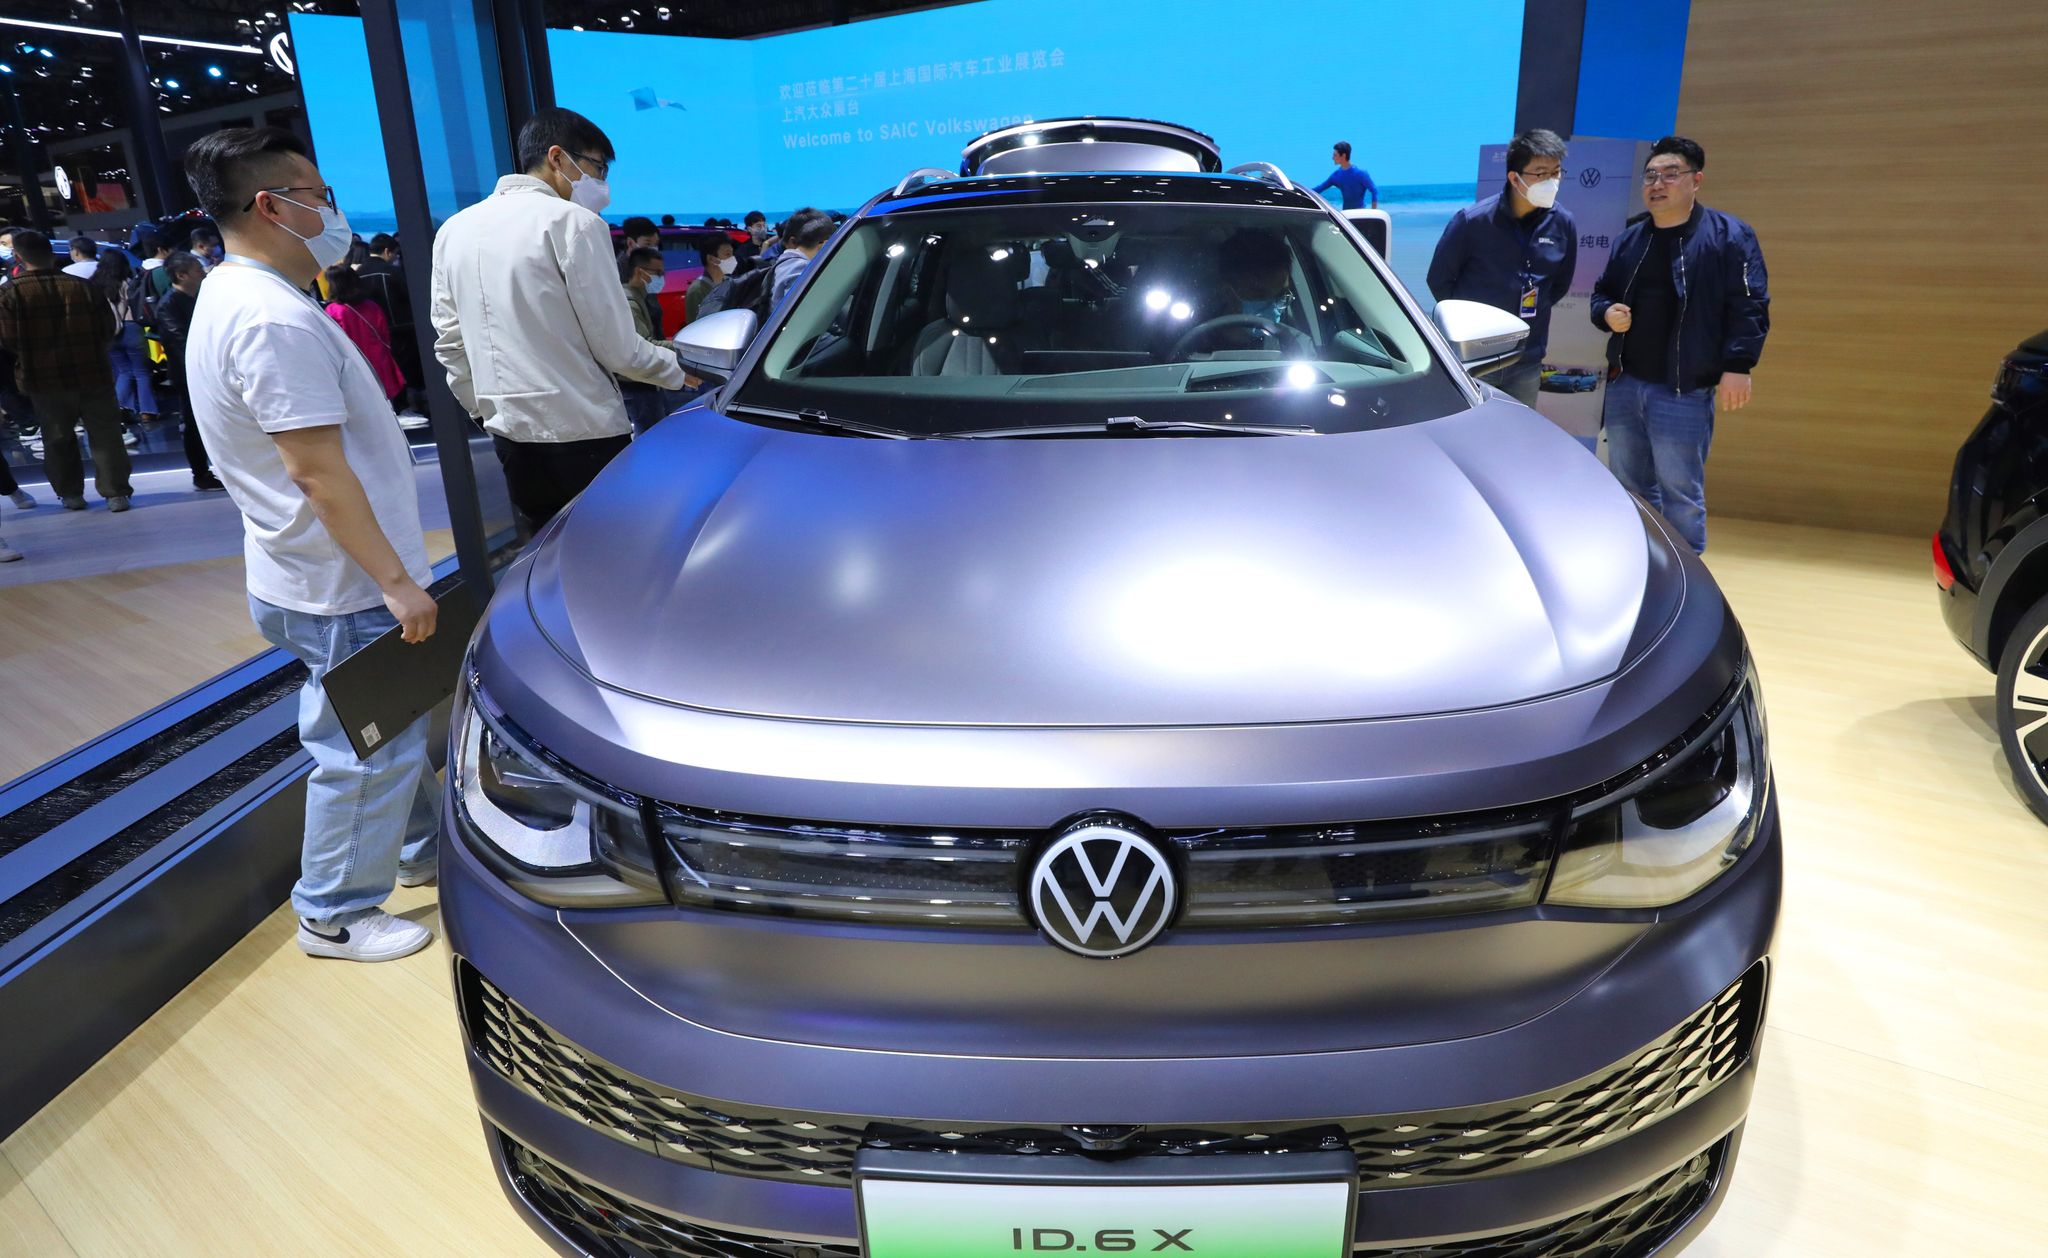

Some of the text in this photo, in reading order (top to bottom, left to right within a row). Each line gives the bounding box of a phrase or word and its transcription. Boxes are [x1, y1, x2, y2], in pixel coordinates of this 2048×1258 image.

[782, 100, 860, 123] 上汽大众展台
[784, 130, 851, 150] Welcome
[857, 127, 873, 142] to
[879, 121, 919, 140] SAIC
[1012, 1227, 1195, 1252] ID.6 X
